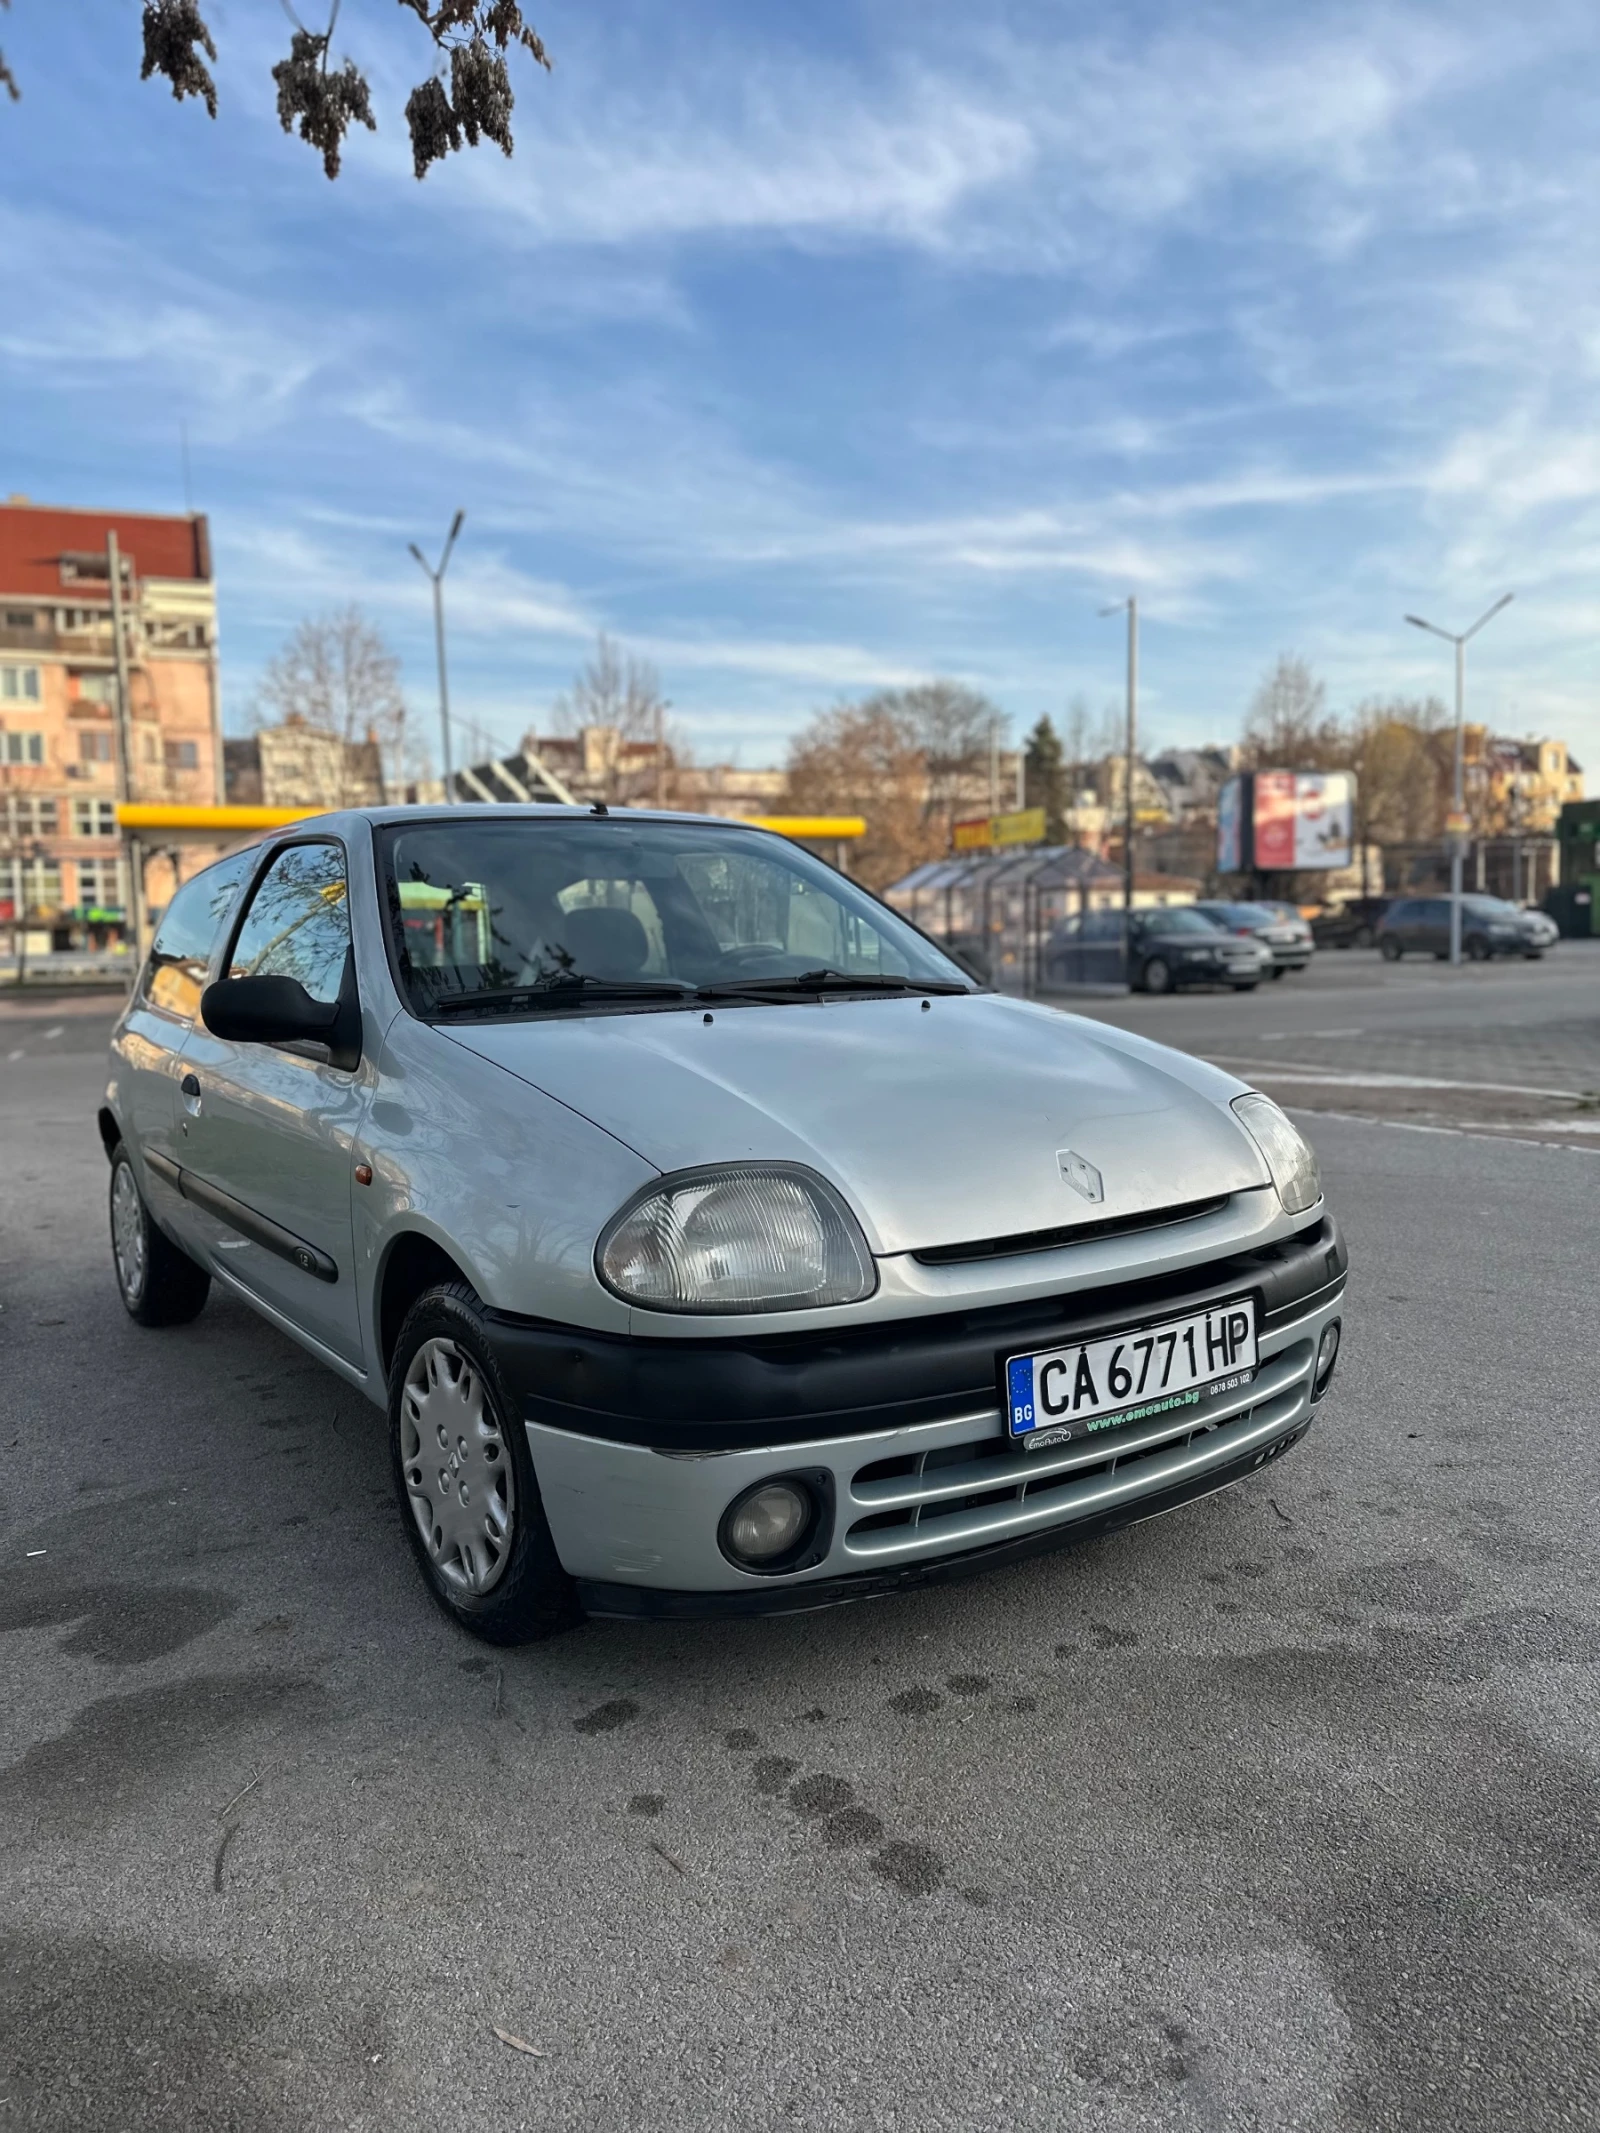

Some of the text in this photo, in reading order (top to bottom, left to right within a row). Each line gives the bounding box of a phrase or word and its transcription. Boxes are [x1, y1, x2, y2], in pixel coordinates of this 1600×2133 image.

[1040, 1312, 1249, 1416] CA 6771 HP
[1210, 1373, 1250, 1395] 0878 503 102
[1014, 1404, 1032, 1424] BG
[1087, 1391, 1200, 1431] www.emoauto.bg
[1029, 1437, 1062, 1449] EmoAuto
